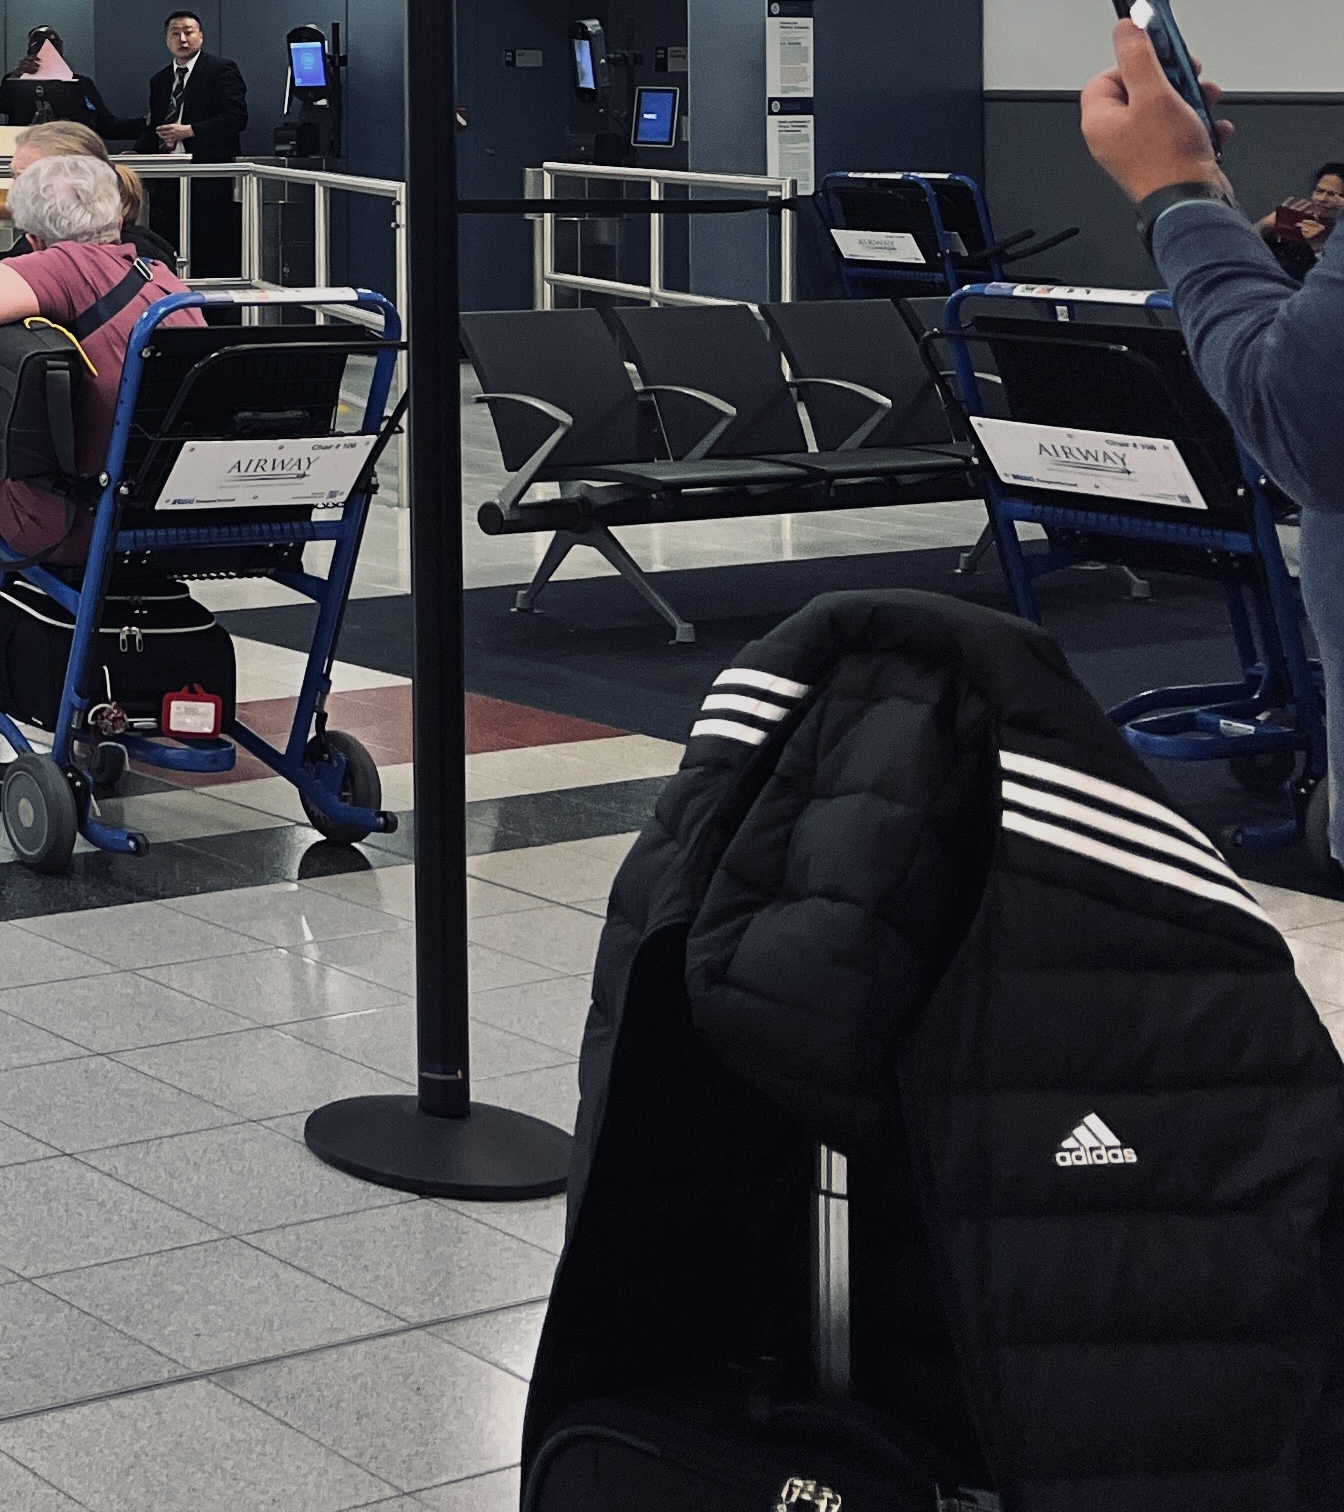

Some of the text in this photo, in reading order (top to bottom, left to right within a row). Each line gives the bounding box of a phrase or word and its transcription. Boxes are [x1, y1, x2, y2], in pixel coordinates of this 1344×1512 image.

[228, 456, 321, 474] AIRWAY
[1038, 442, 1127, 467] AIRWAY
[1055, 1144, 1138, 1167] adidas
